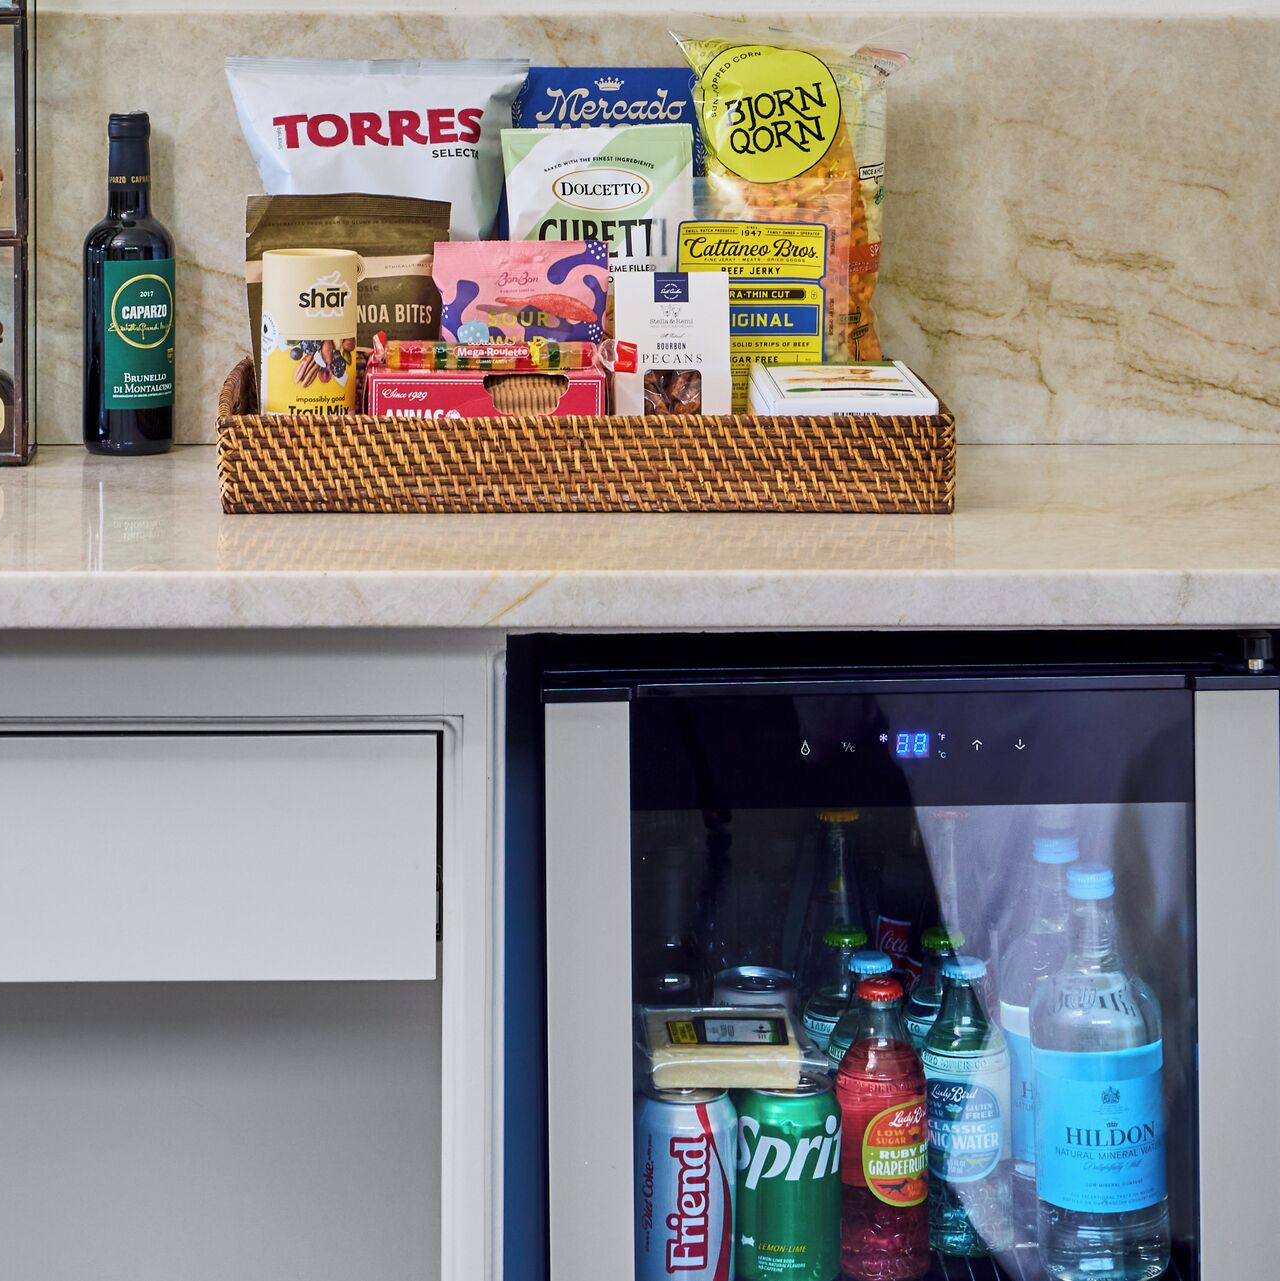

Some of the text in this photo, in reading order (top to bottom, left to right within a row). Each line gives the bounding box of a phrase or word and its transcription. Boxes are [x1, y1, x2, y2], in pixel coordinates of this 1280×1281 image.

[732, 50, 762, 63] CORN
[535, 87, 687, 122] Mercado
[724, 82, 827, 131] BJORN
[272, 107, 485, 149] TORRES
[730, 117, 826, 155] QORN
[432, 148, 479, 160] SELECTA
[543, 162, 562, 173] BAKED
[563, 158, 578, 167] WITH
[614, 156, 655, 169] INGREDIENTS
[741, 229, 762, 237] 1947
[683, 236, 819, 259] Cattaneo Bros.
[609, 263, 657, 273] ÈME FILLED
[721, 267, 781, 275] BEEF JERKY
[729, 290, 790, 300] RA-THIN CUT
[121, 303, 167, 320] CAPARZO
[357, 303, 432, 324] NOA BITES
[488, 310, 549, 327] SOUR
[731, 312, 794, 328] IGINAL
[656, 342, 687, 350] BOURBON
[641, 353, 703, 364] PECANS
[730, 355, 779, 364] GAR FREE
[123, 372, 167, 383] BRUNELLO
[113, 382, 173, 394] DI MONTALCINO
[381, 387, 428, 402] Since 1929
[295, 395, 345, 404] impossibly good
[288, 404, 350, 415] Trail Mix
[931, 1084, 979, 1102] Lady Bird
[965, 1103, 993, 1112] GLUTEN
[965, 1110, 995, 1120] FREE
[888, 1110, 914, 1128] Lady
[927, 1119, 987, 1134] CLASSIC
[876, 1128, 906, 1138] LOW
[876, 1136, 907, 1145] SUGAR
[1065, 1120, 1155, 1147] HILDON
[951, 1132, 999, 1150] WATER
[879, 1147, 917, 1160] RUBY
[1055, 1145, 1095, 1160] NATURAL
[1098, 1147, 1139, 1160] MINERAL
[868, 1155, 925, 1177] GRAPEFRUIT
[668, 1135, 708, 1269] Friend
